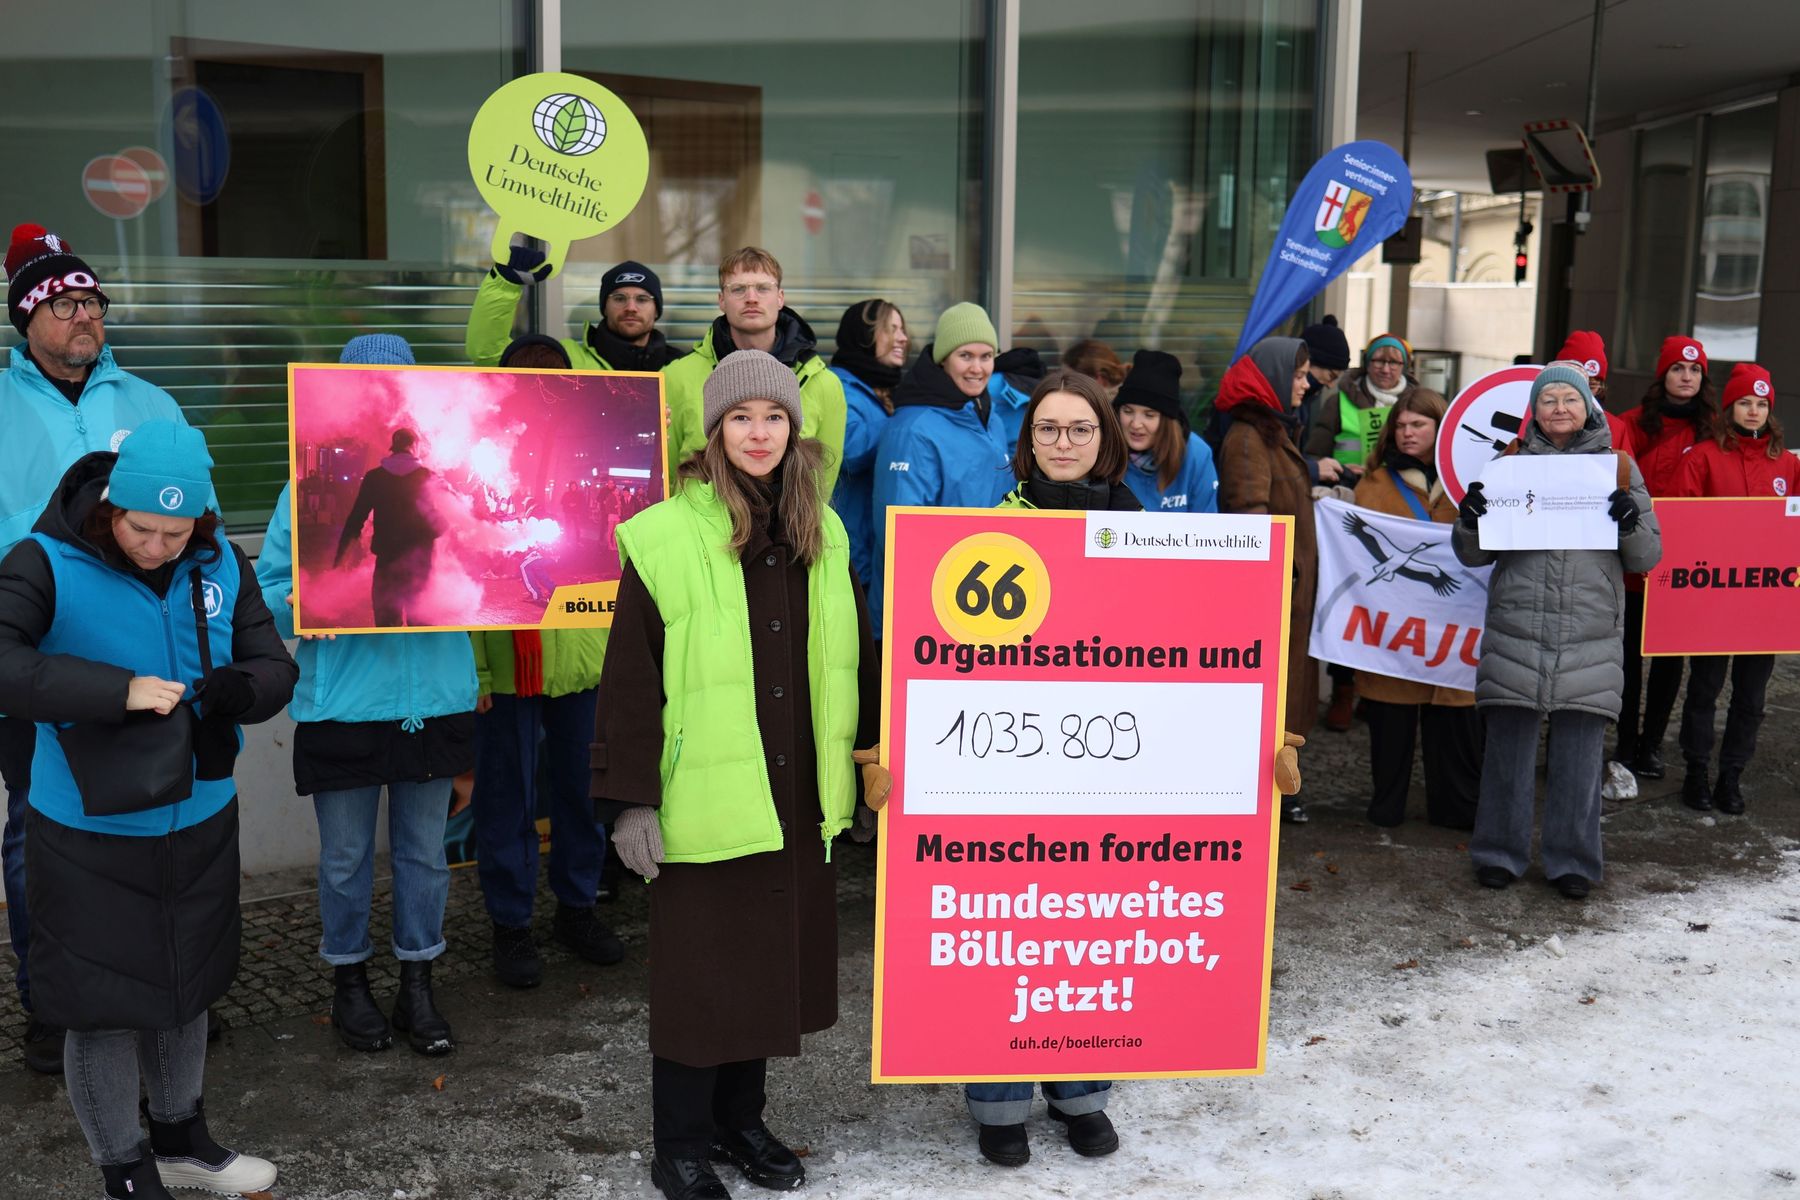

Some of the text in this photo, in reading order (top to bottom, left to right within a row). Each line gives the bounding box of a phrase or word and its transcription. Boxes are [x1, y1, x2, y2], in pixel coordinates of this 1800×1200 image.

[509, 144, 602, 191] Deutsche
[486, 164, 608, 222] Umwelthilfe
[1124, 532, 1262, 549] Deutsche Umwelthilfe
[955, 560, 1027, 620] 66
[914, 635, 1262, 673] Organisationen und
[916, 833, 1243, 862] Menschen fordern:
[931, 880, 1225, 920] Bundesweites
[930, 929, 1221, 971] Böllerverbot,
[1009, 975, 1134, 1023] jetzt!
[1009, 1035, 1143, 1053] duh.de/boellerciao
